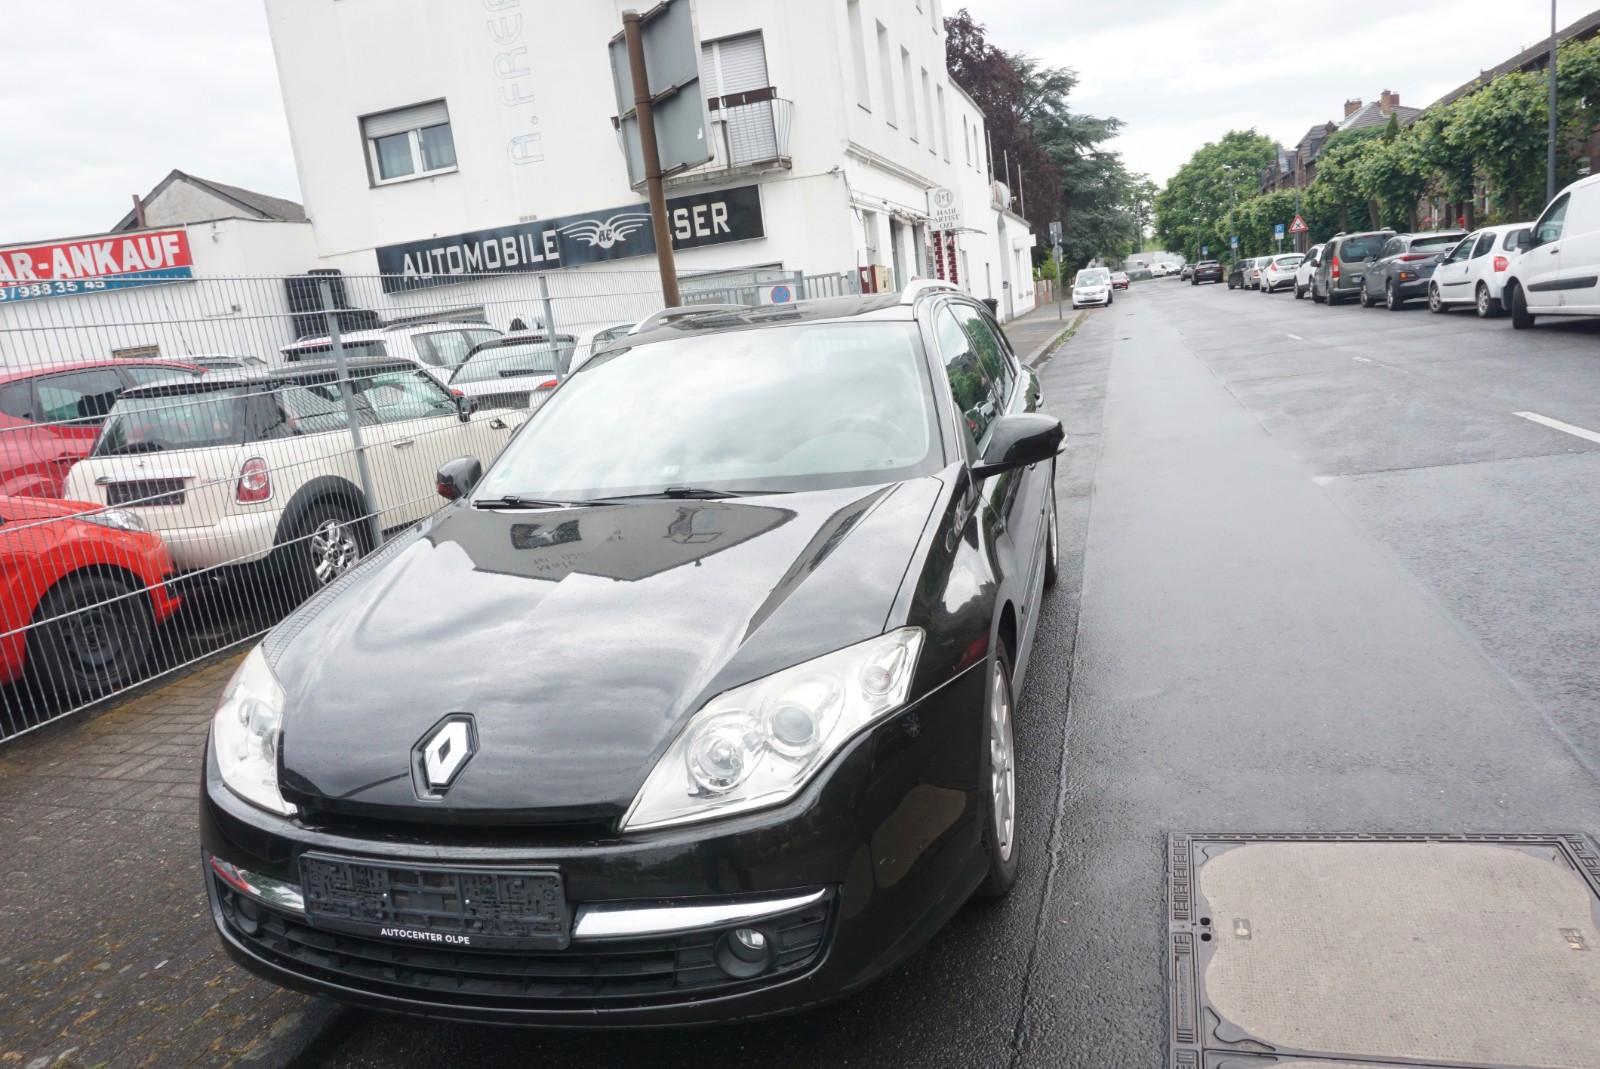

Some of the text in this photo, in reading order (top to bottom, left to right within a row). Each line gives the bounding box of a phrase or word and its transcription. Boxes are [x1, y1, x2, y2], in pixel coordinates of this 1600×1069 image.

[0, 234, 179, 281] AR-ANKAUF
[403, 201, 731, 282] AUTOMOBILE SER
[55, 281, 78, 293] 35
[381, 928, 470, 945] AUTOCENTER OLPE
